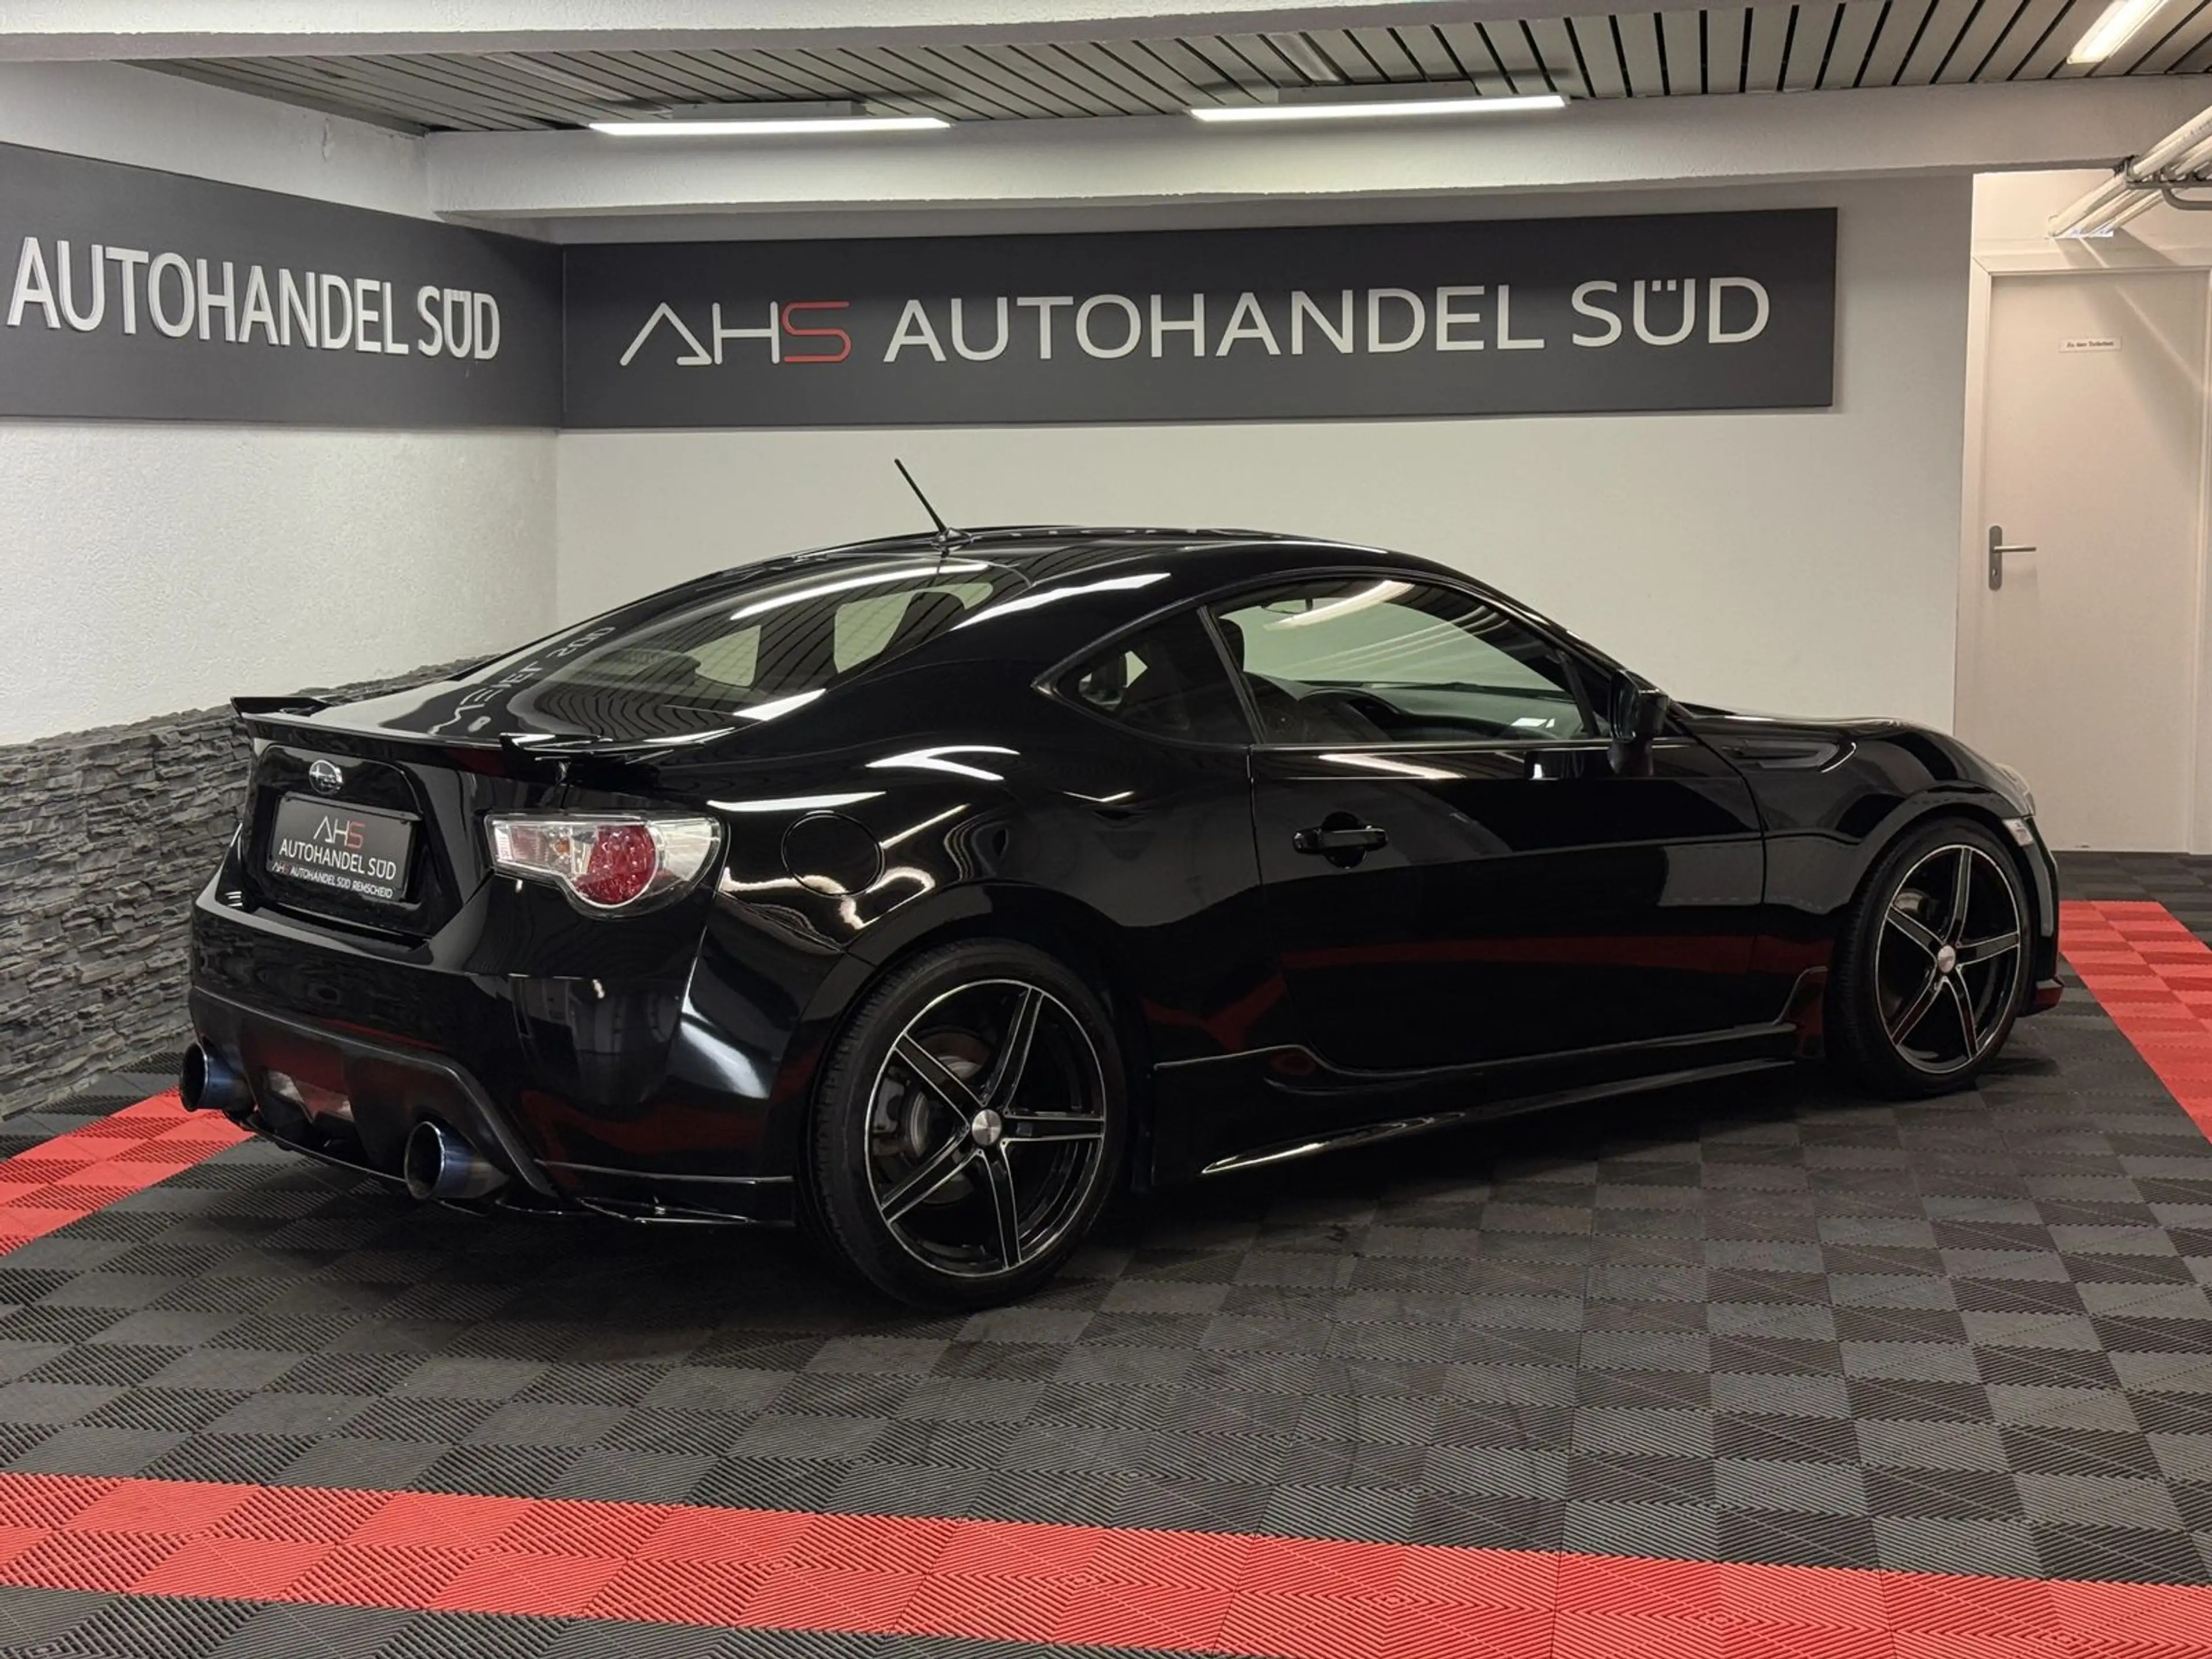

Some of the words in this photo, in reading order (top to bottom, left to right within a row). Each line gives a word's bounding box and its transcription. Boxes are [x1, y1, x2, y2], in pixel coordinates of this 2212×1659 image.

[7, 237, 408, 354] AUTOHANDEL
[418, 286, 500, 359] SÜD
[620, 301, 851, 365] AHS
[883, 285, 1544, 363] AUTOHANDEL
[1571, 276, 1770, 347] SÜD
[313, 816, 365, 849] AHS
[279, 839, 365, 874] AUTOHANDEL
[367, 858, 397, 880] SÜD
[290, 866, 335, 886] AUTOHANDEL
[351, 880, 393, 899] REMSCHEID
